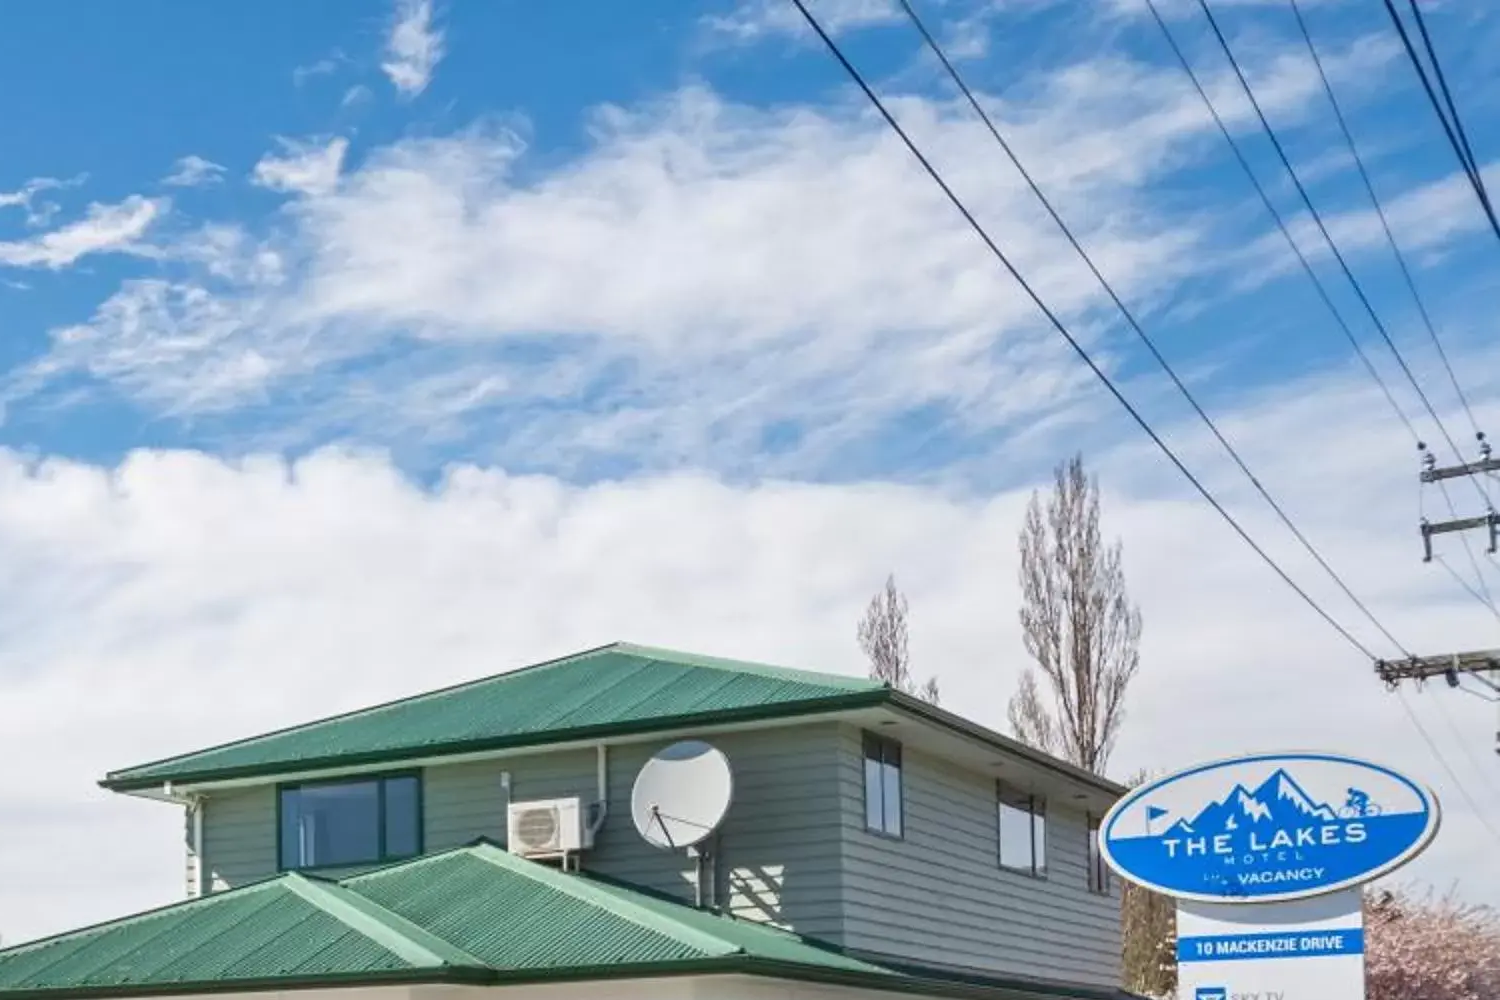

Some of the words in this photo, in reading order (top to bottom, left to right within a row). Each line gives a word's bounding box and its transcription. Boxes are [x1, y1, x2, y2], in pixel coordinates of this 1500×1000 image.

[1162, 834, 1233, 857] THE
[1251, 823, 1367, 851] LAKES
[1224, 851, 1304, 865] MOTEL
[1238, 867, 1325, 885] VACANCY
[1195, 942, 1213, 955] 10
[1216, 937, 1298, 954] MACKENZIE
[1301, 935, 1344, 951] DRIVE
